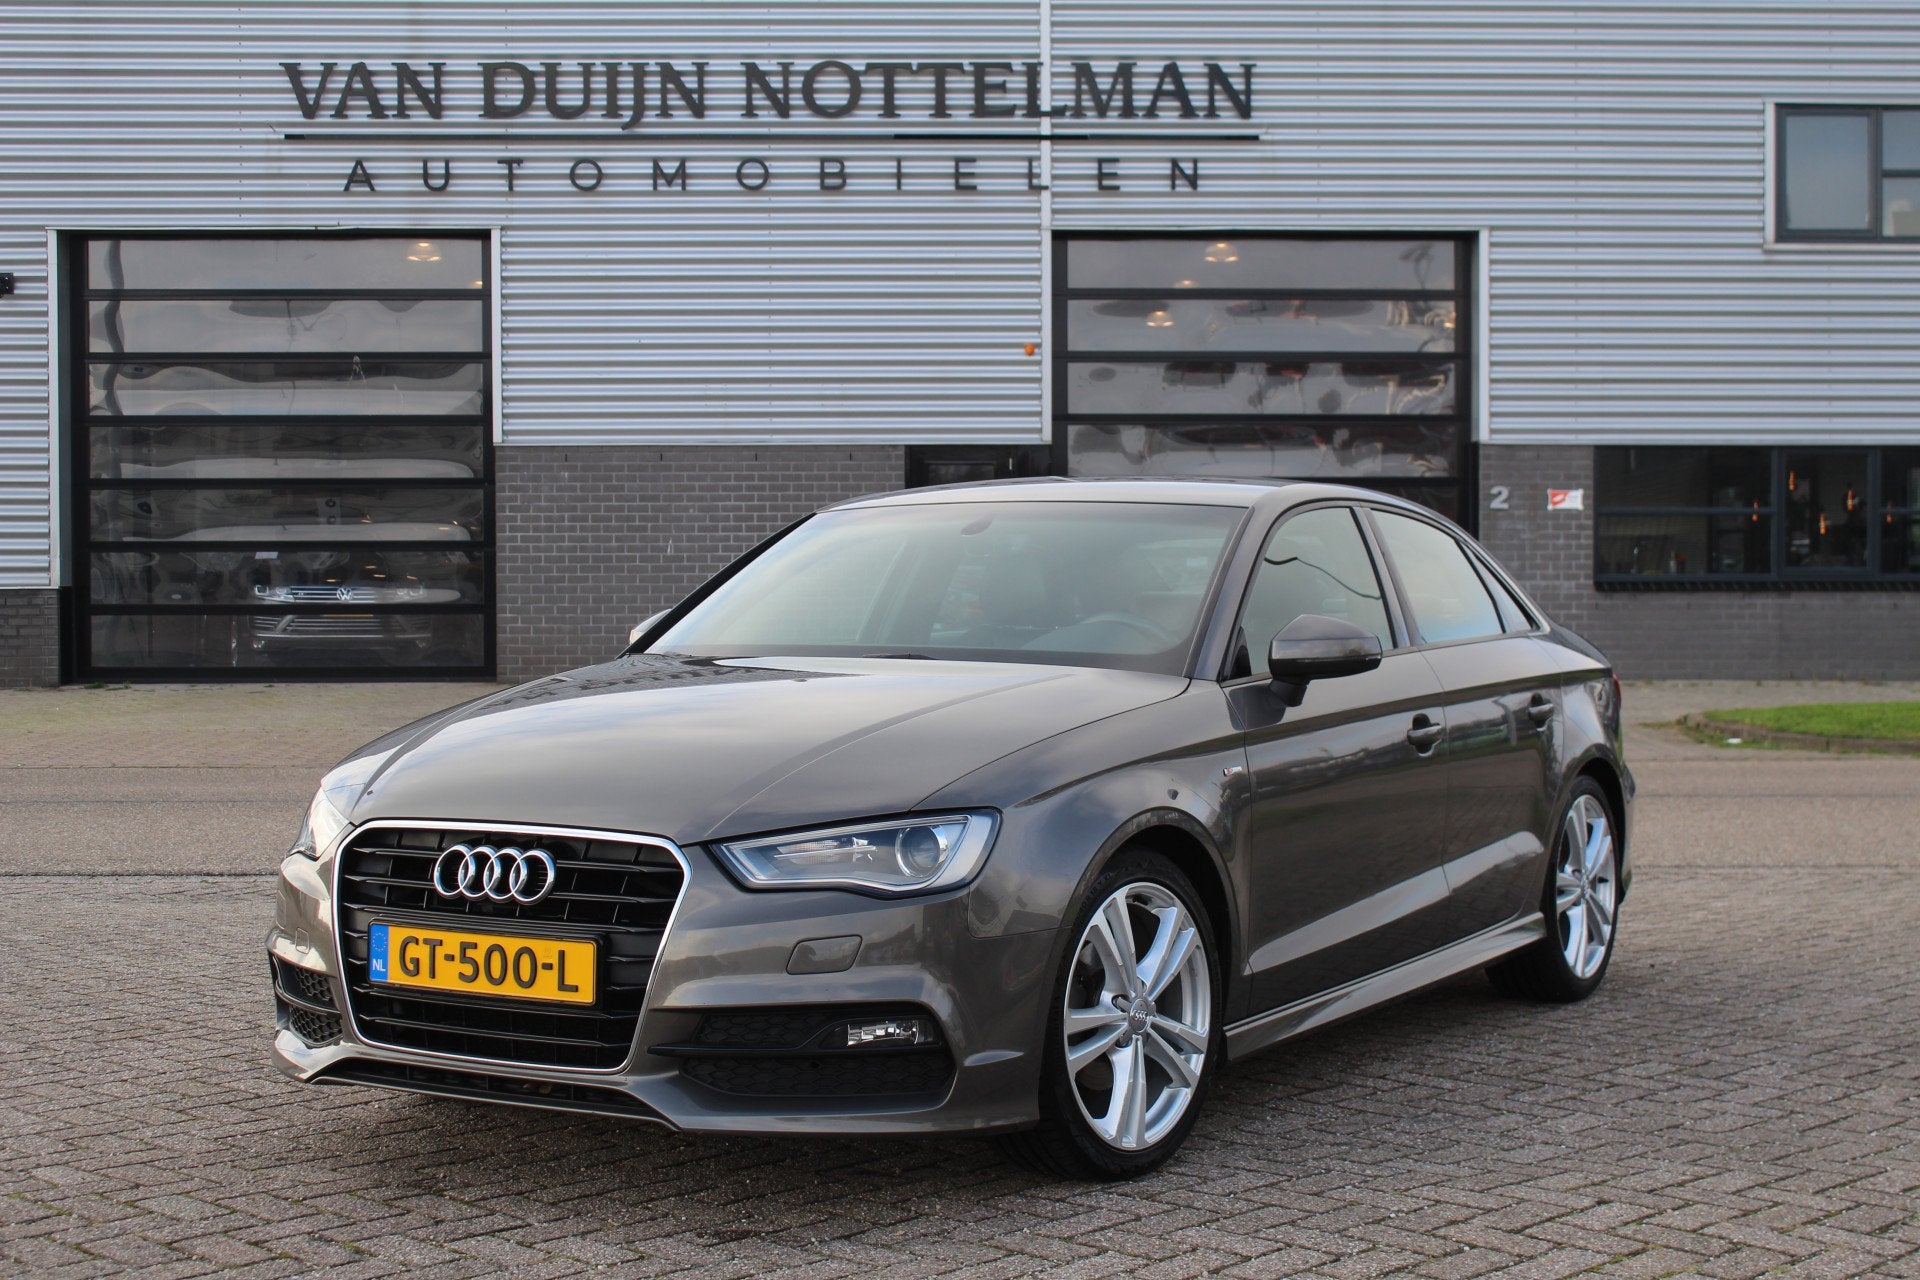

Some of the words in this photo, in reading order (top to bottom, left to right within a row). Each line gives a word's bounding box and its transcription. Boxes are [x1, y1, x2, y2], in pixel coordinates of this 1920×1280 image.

[279, 61, 446, 119] VAN
[477, 61, 709, 131] DUIJN
[740, 60, 1258, 119] NOTTELMAN
[343, 158, 1199, 191] AUTOMOBILEN
[1489, 485, 1510, 510] 2
[372, 958, 386, 972] NL
[399, 935, 579, 993] GT-500-L
